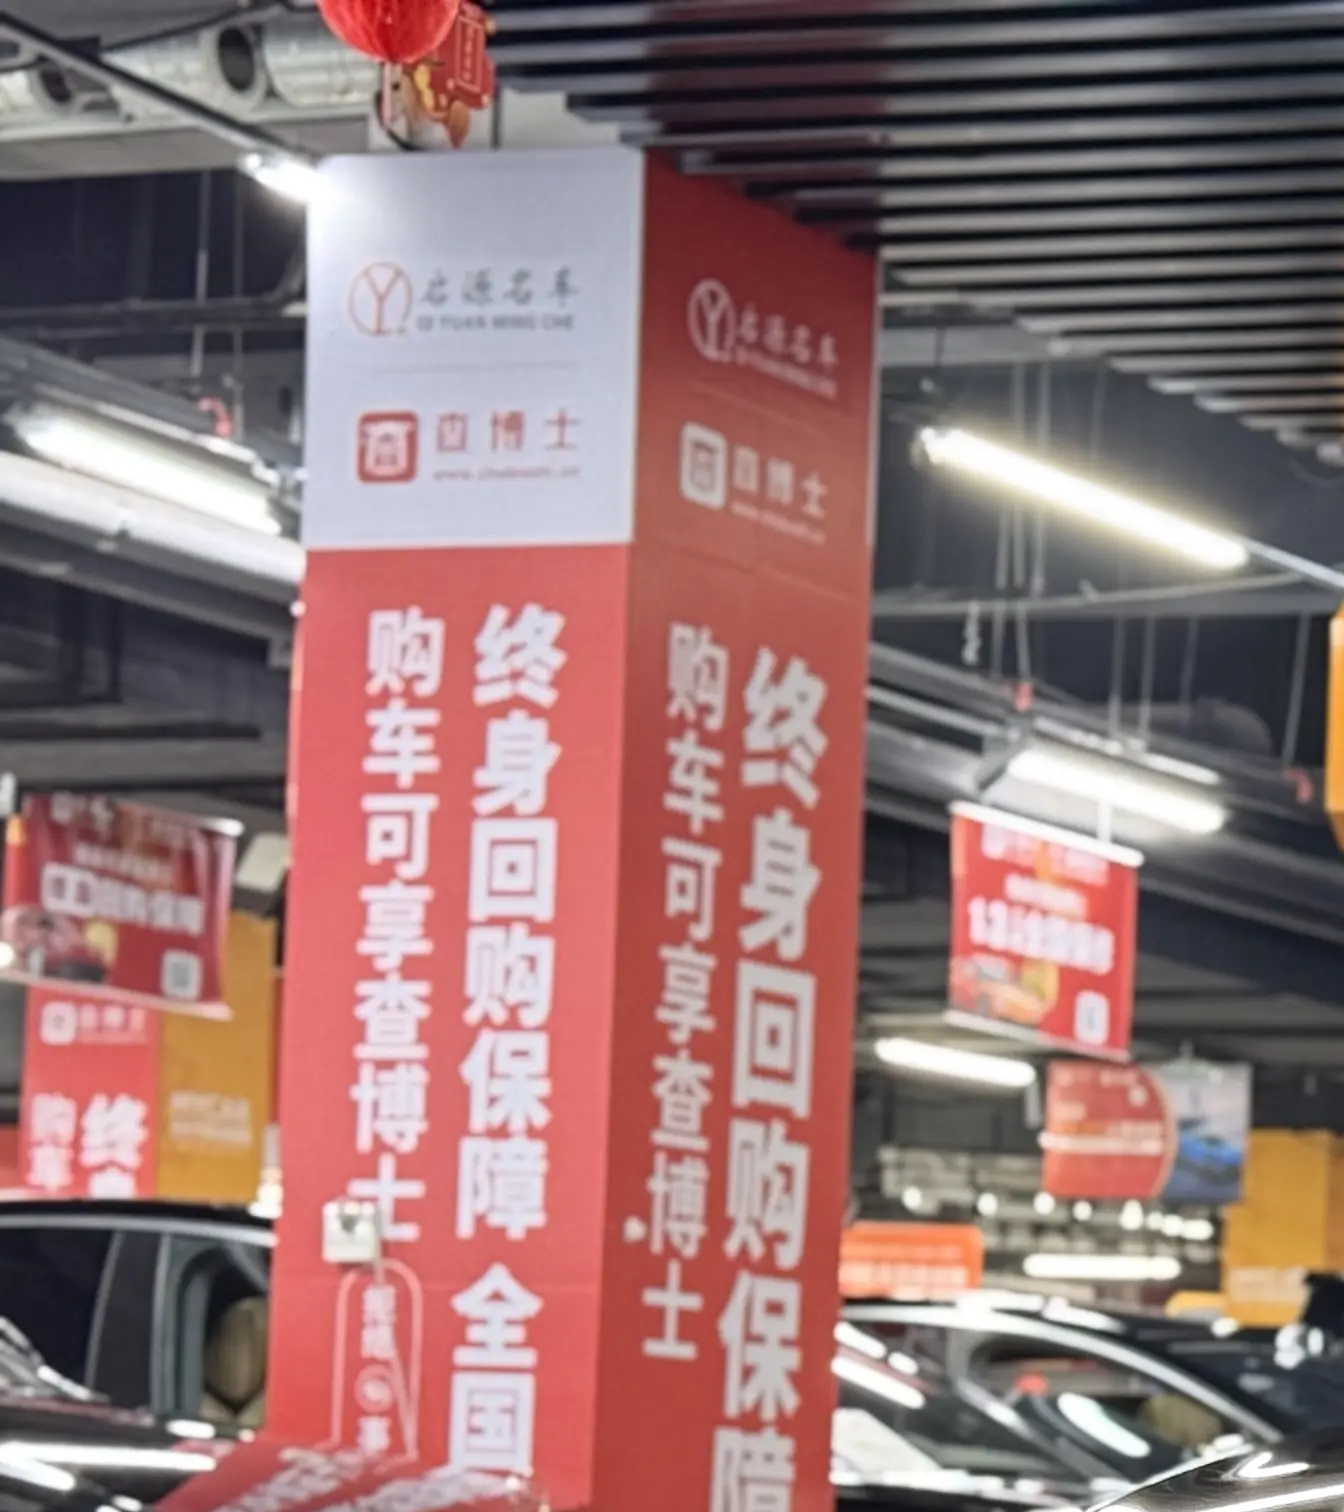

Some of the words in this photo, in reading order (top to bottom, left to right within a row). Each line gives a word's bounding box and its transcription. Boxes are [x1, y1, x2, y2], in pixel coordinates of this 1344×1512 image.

[348, 605, 445, 1242] 购车可享查博士
[455, 604, 567, 1240] 终身回购保障
[642, 621, 729, 1360] 购车可享查博士
[449, 1262, 544, 1471] 全国
